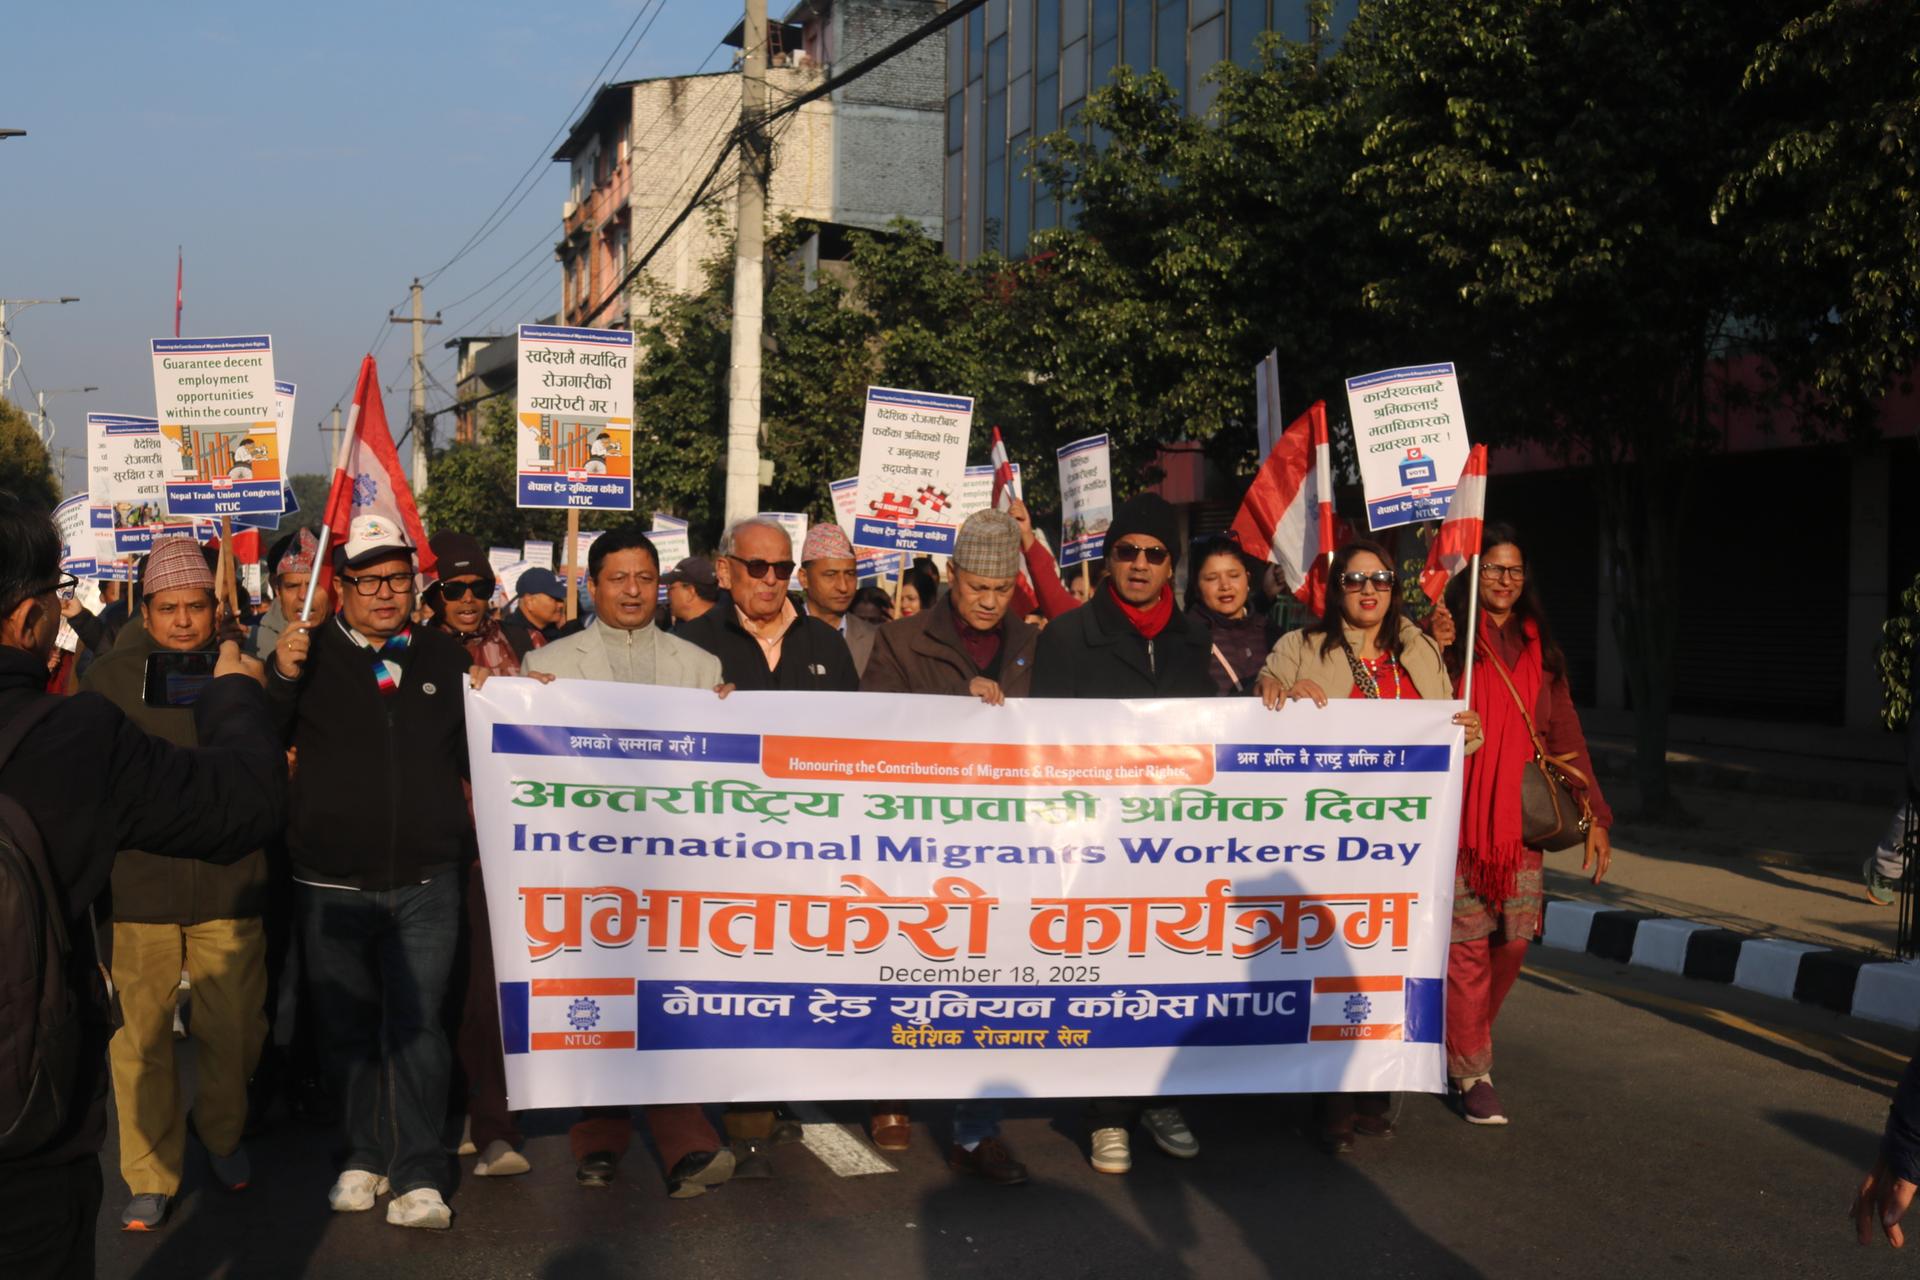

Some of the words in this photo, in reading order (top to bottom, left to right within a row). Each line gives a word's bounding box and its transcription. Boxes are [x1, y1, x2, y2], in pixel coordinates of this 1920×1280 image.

[163, 357, 222, 370] Guarantee
[223, 356, 263, 368] decent
[526, 347, 575, 365] स्वदेशमै
[579, 351, 628, 369] मर्यादित
[178, 373, 249, 388] employment
[542, 370, 612, 390] रोजगारीको
[176, 389, 254, 404] opportunities
[589, 399, 609, 413] गर
[166, 407, 201, 419] within
[203, 406, 221, 418] the
[223, 405, 269, 418] country
[1373, 397, 1439, 419] श्रमिकलाई
[1368, 413, 1451, 437] मताधिकारको
[1369, 435, 1416, 454] व्यवस्था
[1421, 433, 1441, 444] गर
[170, 492, 192, 502] Nepal
[193, 492, 215, 500] Trade
[217, 491, 241, 499] Union
[243, 489, 281, 499] Congress
[528, 481, 552, 492] नेपाल
[215, 502, 241, 512] NTUC
[568, 495, 593, 505] NTUC
[1415, 508, 1440, 519] NTUC
[896, 538, 919, 549] NTUC
[570, 733, 612, 750] श्रमको
[618, 737, 663, 752] सम्मान
[701, 737, 707, 755] !
[1237, 751, 1259, 765] श्रम
[1264, 748, 1296, 767] शक्ति
[1300, 747, 1310, 765] नै
[1314, 752, 1343, 769] राष्ट्र
[1348, 748, 1380, 767] शक्ति
[1383, 750, 1396, 768] हो
[1400, 749, 1405, 765] !
[789, 757, 853, 775] Honouring
[855, 760, 875, 773] the
[877, 760, 960, 776] Contributions
[961, 763, 973, 776] of
[977, 763, 1030, 780] Migrants
[1032, 765, 1041, 778] &
[1045, 765, 1113, 780] Respecting
[1115, 765, 1144, 778] their
[510, 779, 845, 824] अन्तर्राष्ट्रिय
[863, 789, 1101, 825] आप्रवासी
[1119, 787, 1287, 823] श्रमिक
[1305, 787, 1432, 823] दिवस
[512, 823, 861, 862] International
[876, 834, 1106, 869] Migrants
[1118, 836, 1325, 864] Workers
[1337, 836, 1421, 866] Day
[518, 873, 999, 963] प्रभातफेरी
[1028, 878, 1418, 960] कार्यक्रम
[879, 965, 1001, 983] December
[1011, 966, 1040, 986] 18,
[1048, 965, 1101, 983] 2025
[662, 985, 796, 1018] नेपाल
[808, 987, 877, 1024] ट्रेड
[890, 989, 1056, 1025] युनियन
[1206, 990, 1297, 1018] NTUC
[565, 1034, 601, 1046] NTUC
[891, 1023, 965, 1048] वैदेशिक
[973, 1025, 1049, 1048] रोजगार
[1057, 1025, 1091, 1048] सेल
[1340, 1026, 1372, 1037] NTUC
